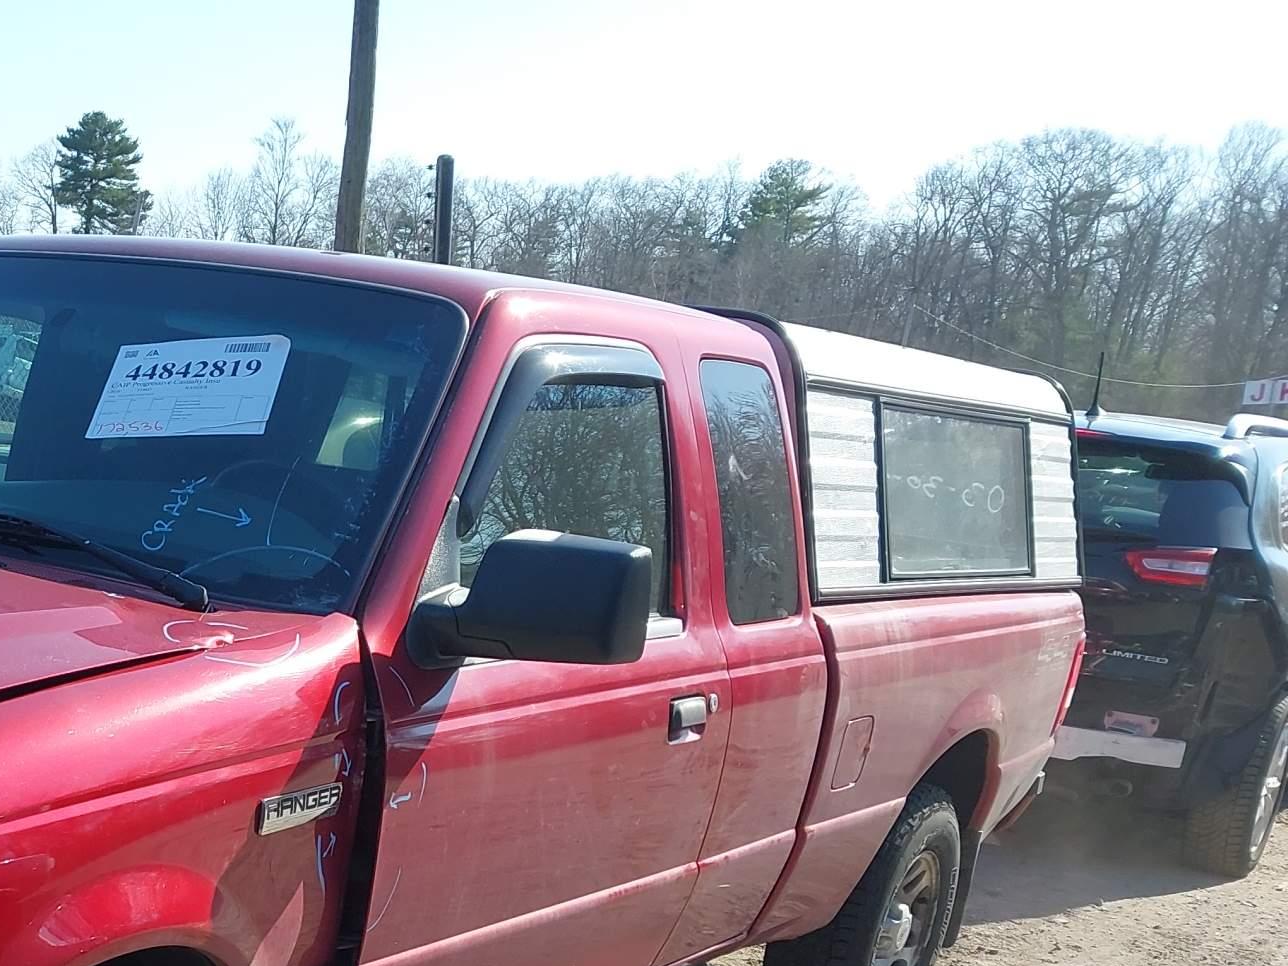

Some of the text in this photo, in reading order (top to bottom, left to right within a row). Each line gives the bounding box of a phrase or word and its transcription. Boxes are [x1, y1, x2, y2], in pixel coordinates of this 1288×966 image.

[125, 359, 263, 381] 44842819
[1102, 648, 1169, 664] LIMITED
[266, 784, 342, 820] RANGER
